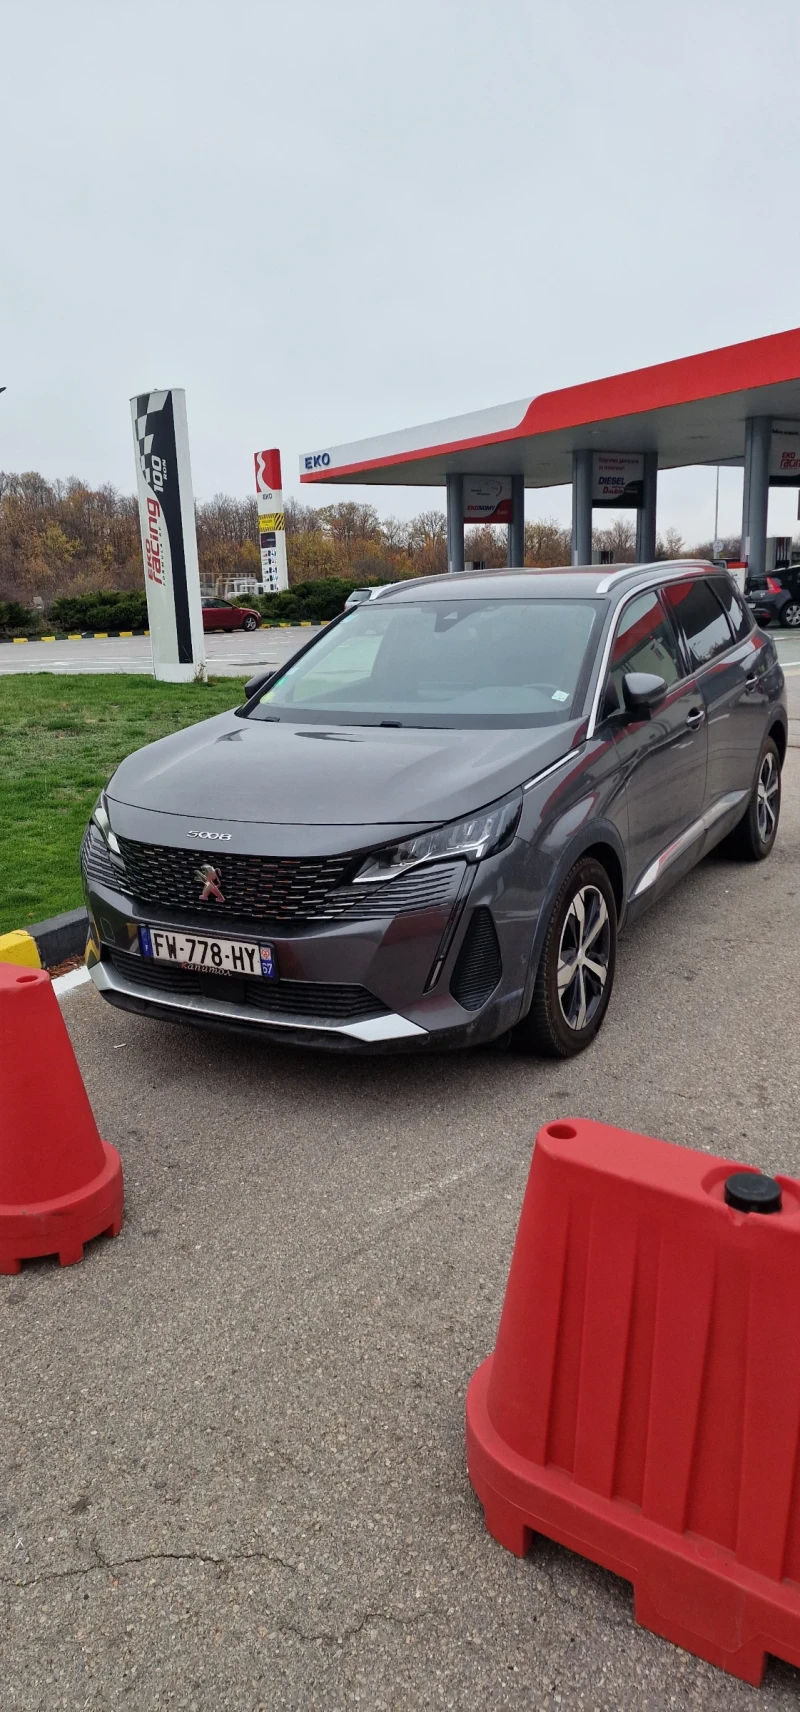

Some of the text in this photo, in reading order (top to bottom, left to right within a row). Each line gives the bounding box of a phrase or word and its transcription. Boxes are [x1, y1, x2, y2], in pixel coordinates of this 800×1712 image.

[305, 453, 331, 469] EKO
[780, 459, 800, 468] racin
[151, 455, 164, 492] 100
[598, 477, 625, 485] DIESEL
[602, 486, 624, 494] Double
[146, 497, 163, 585] racing
[145, 538, 154, 581] EKO
[186, 830, 232, 841] 5008
[153, 933, 256, 973] FW-778-HY
[262, 962, 273, 975] 67
